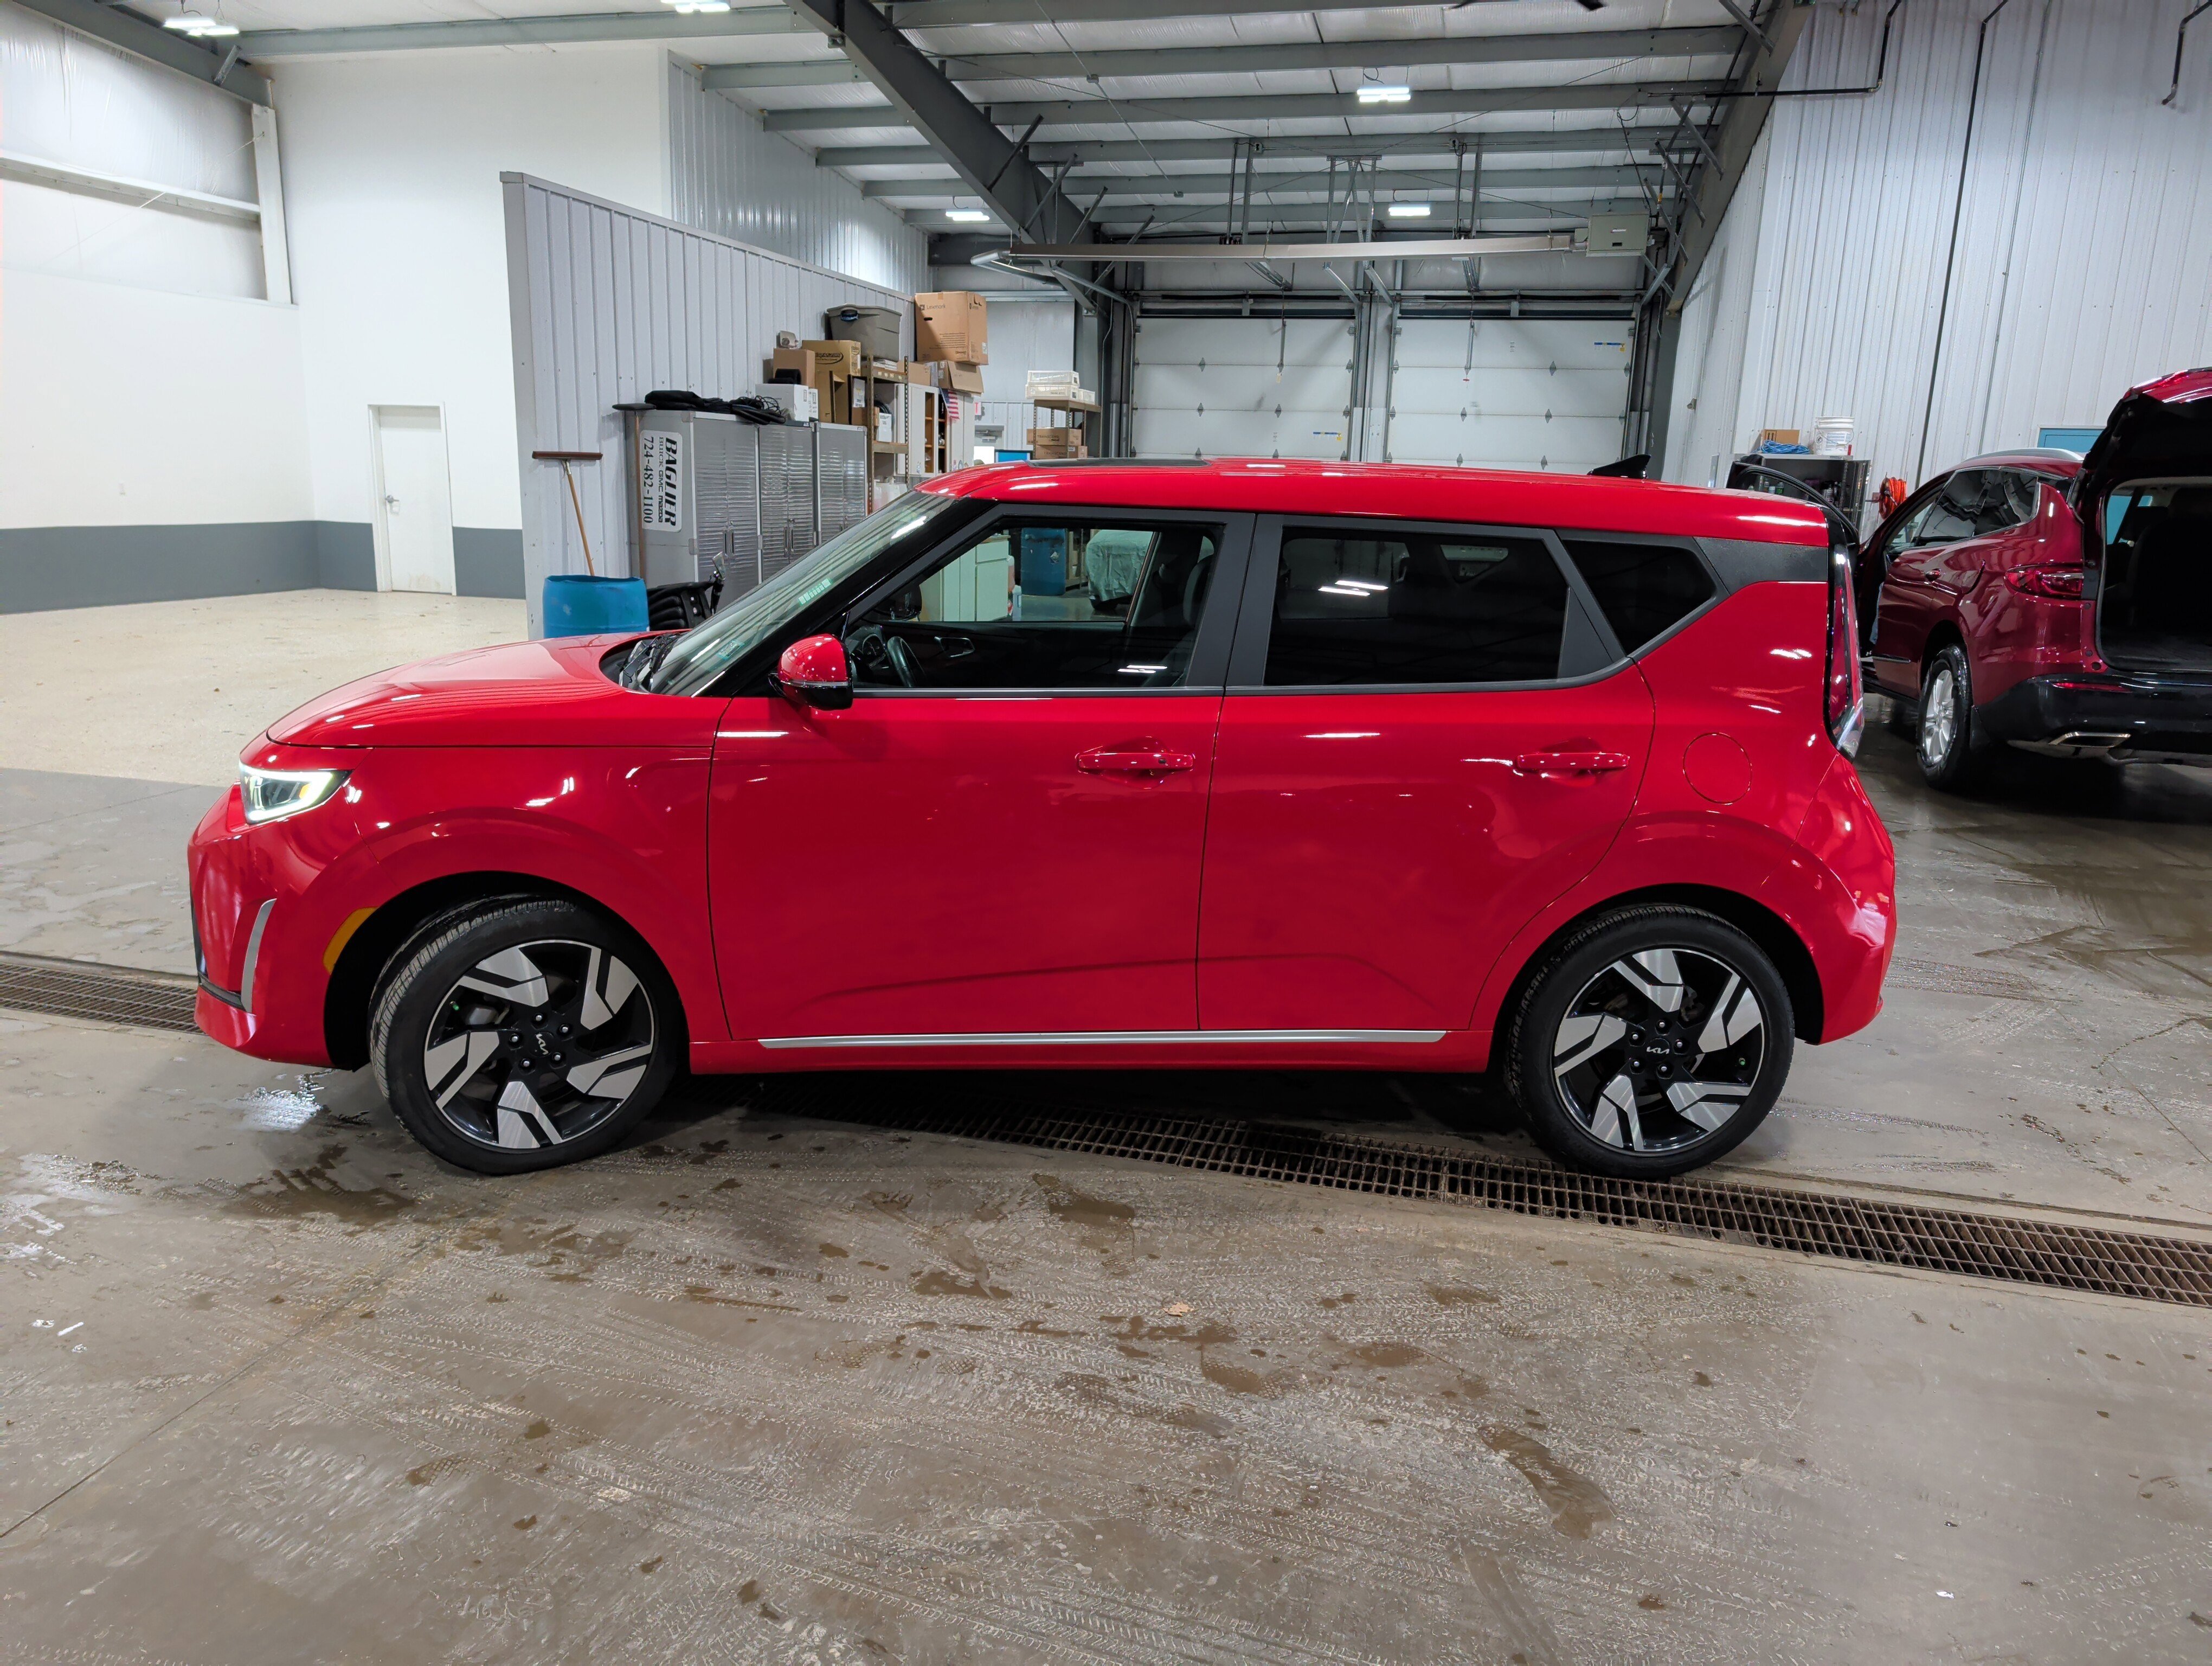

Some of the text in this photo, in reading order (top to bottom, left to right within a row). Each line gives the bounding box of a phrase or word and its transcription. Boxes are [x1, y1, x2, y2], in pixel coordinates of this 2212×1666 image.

[643, 437, 654, 523] 724-482-1100
[665, 437, 677, 526] BAGLIER
[1646, 1046, 1670, 1055] KIA
